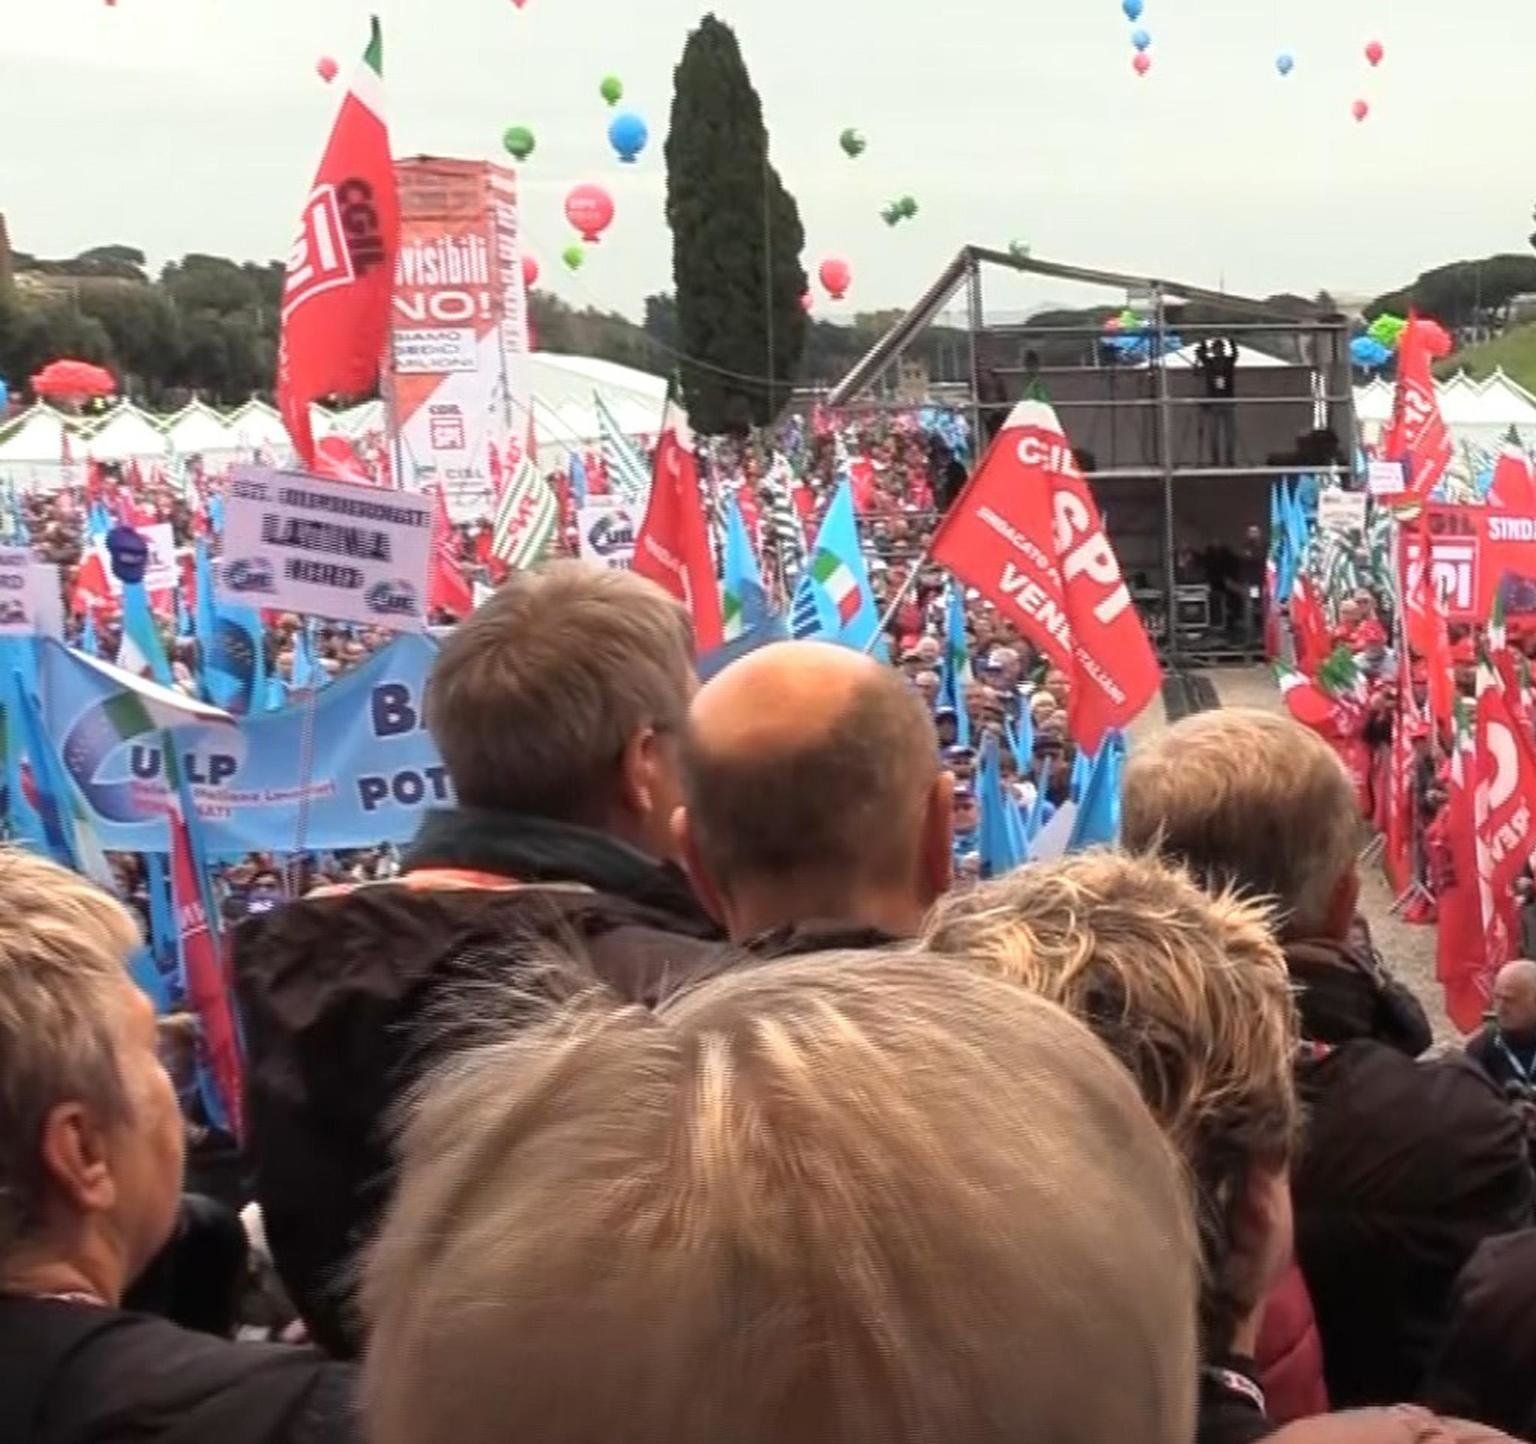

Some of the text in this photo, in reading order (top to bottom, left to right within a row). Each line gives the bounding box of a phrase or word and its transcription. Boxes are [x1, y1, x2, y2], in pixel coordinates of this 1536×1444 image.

[337, 177, 385, 276] CGIL
[395, 234, 488, 286] visibili
[262, 514, 391, 562] LATINA
[1054, 490, 1130, 624] SPI
[285, 558, 364, 589] NORD
[130, 746, 237, 785] ULP
